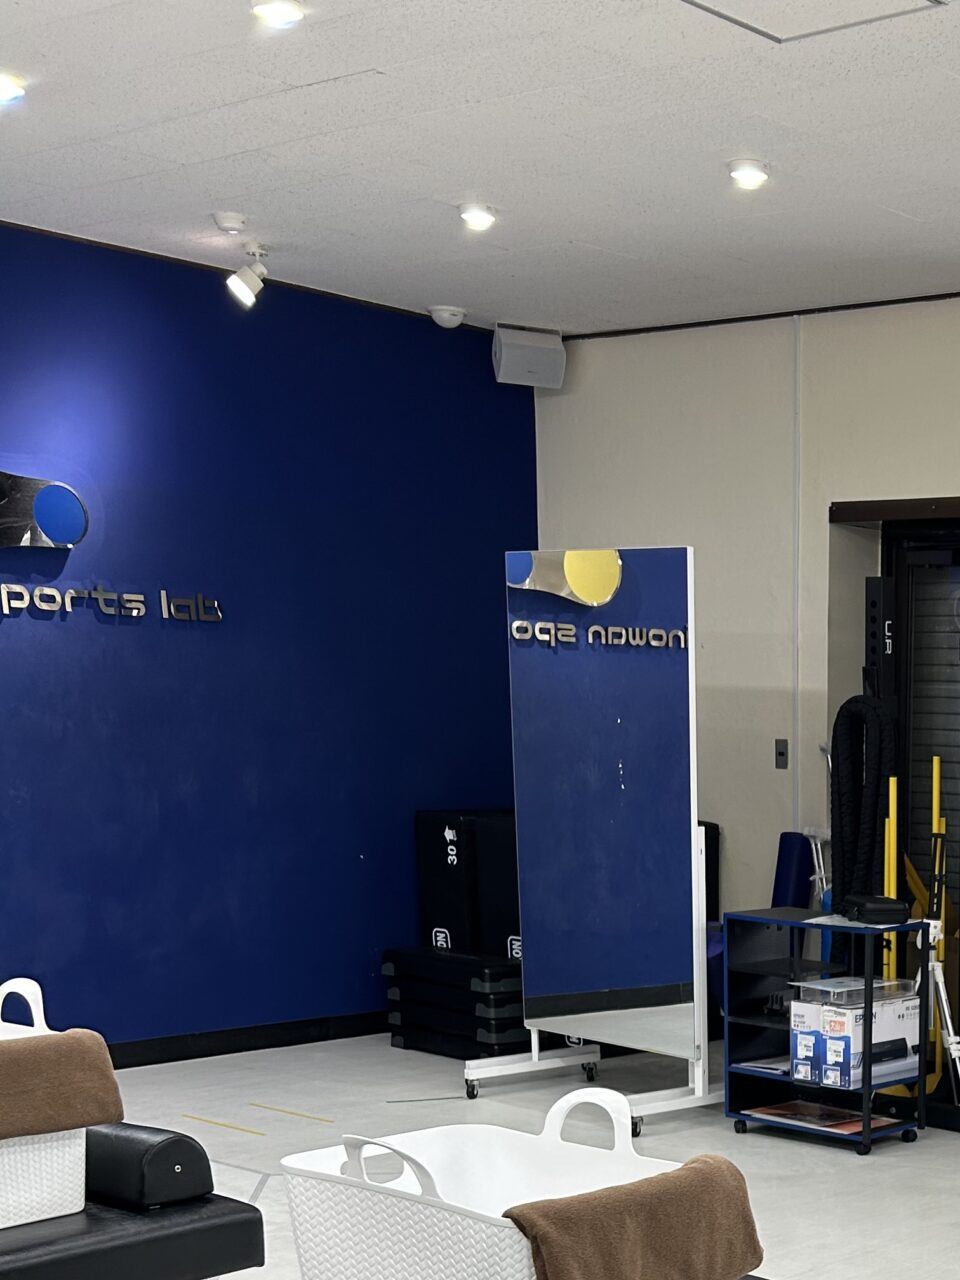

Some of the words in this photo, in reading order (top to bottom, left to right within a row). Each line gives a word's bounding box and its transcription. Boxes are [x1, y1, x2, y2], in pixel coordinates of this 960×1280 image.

[160, 589, 223, 621] lab
[446, 845, 458, 865] 30
[854, 1012, 877, 1024] EPN
